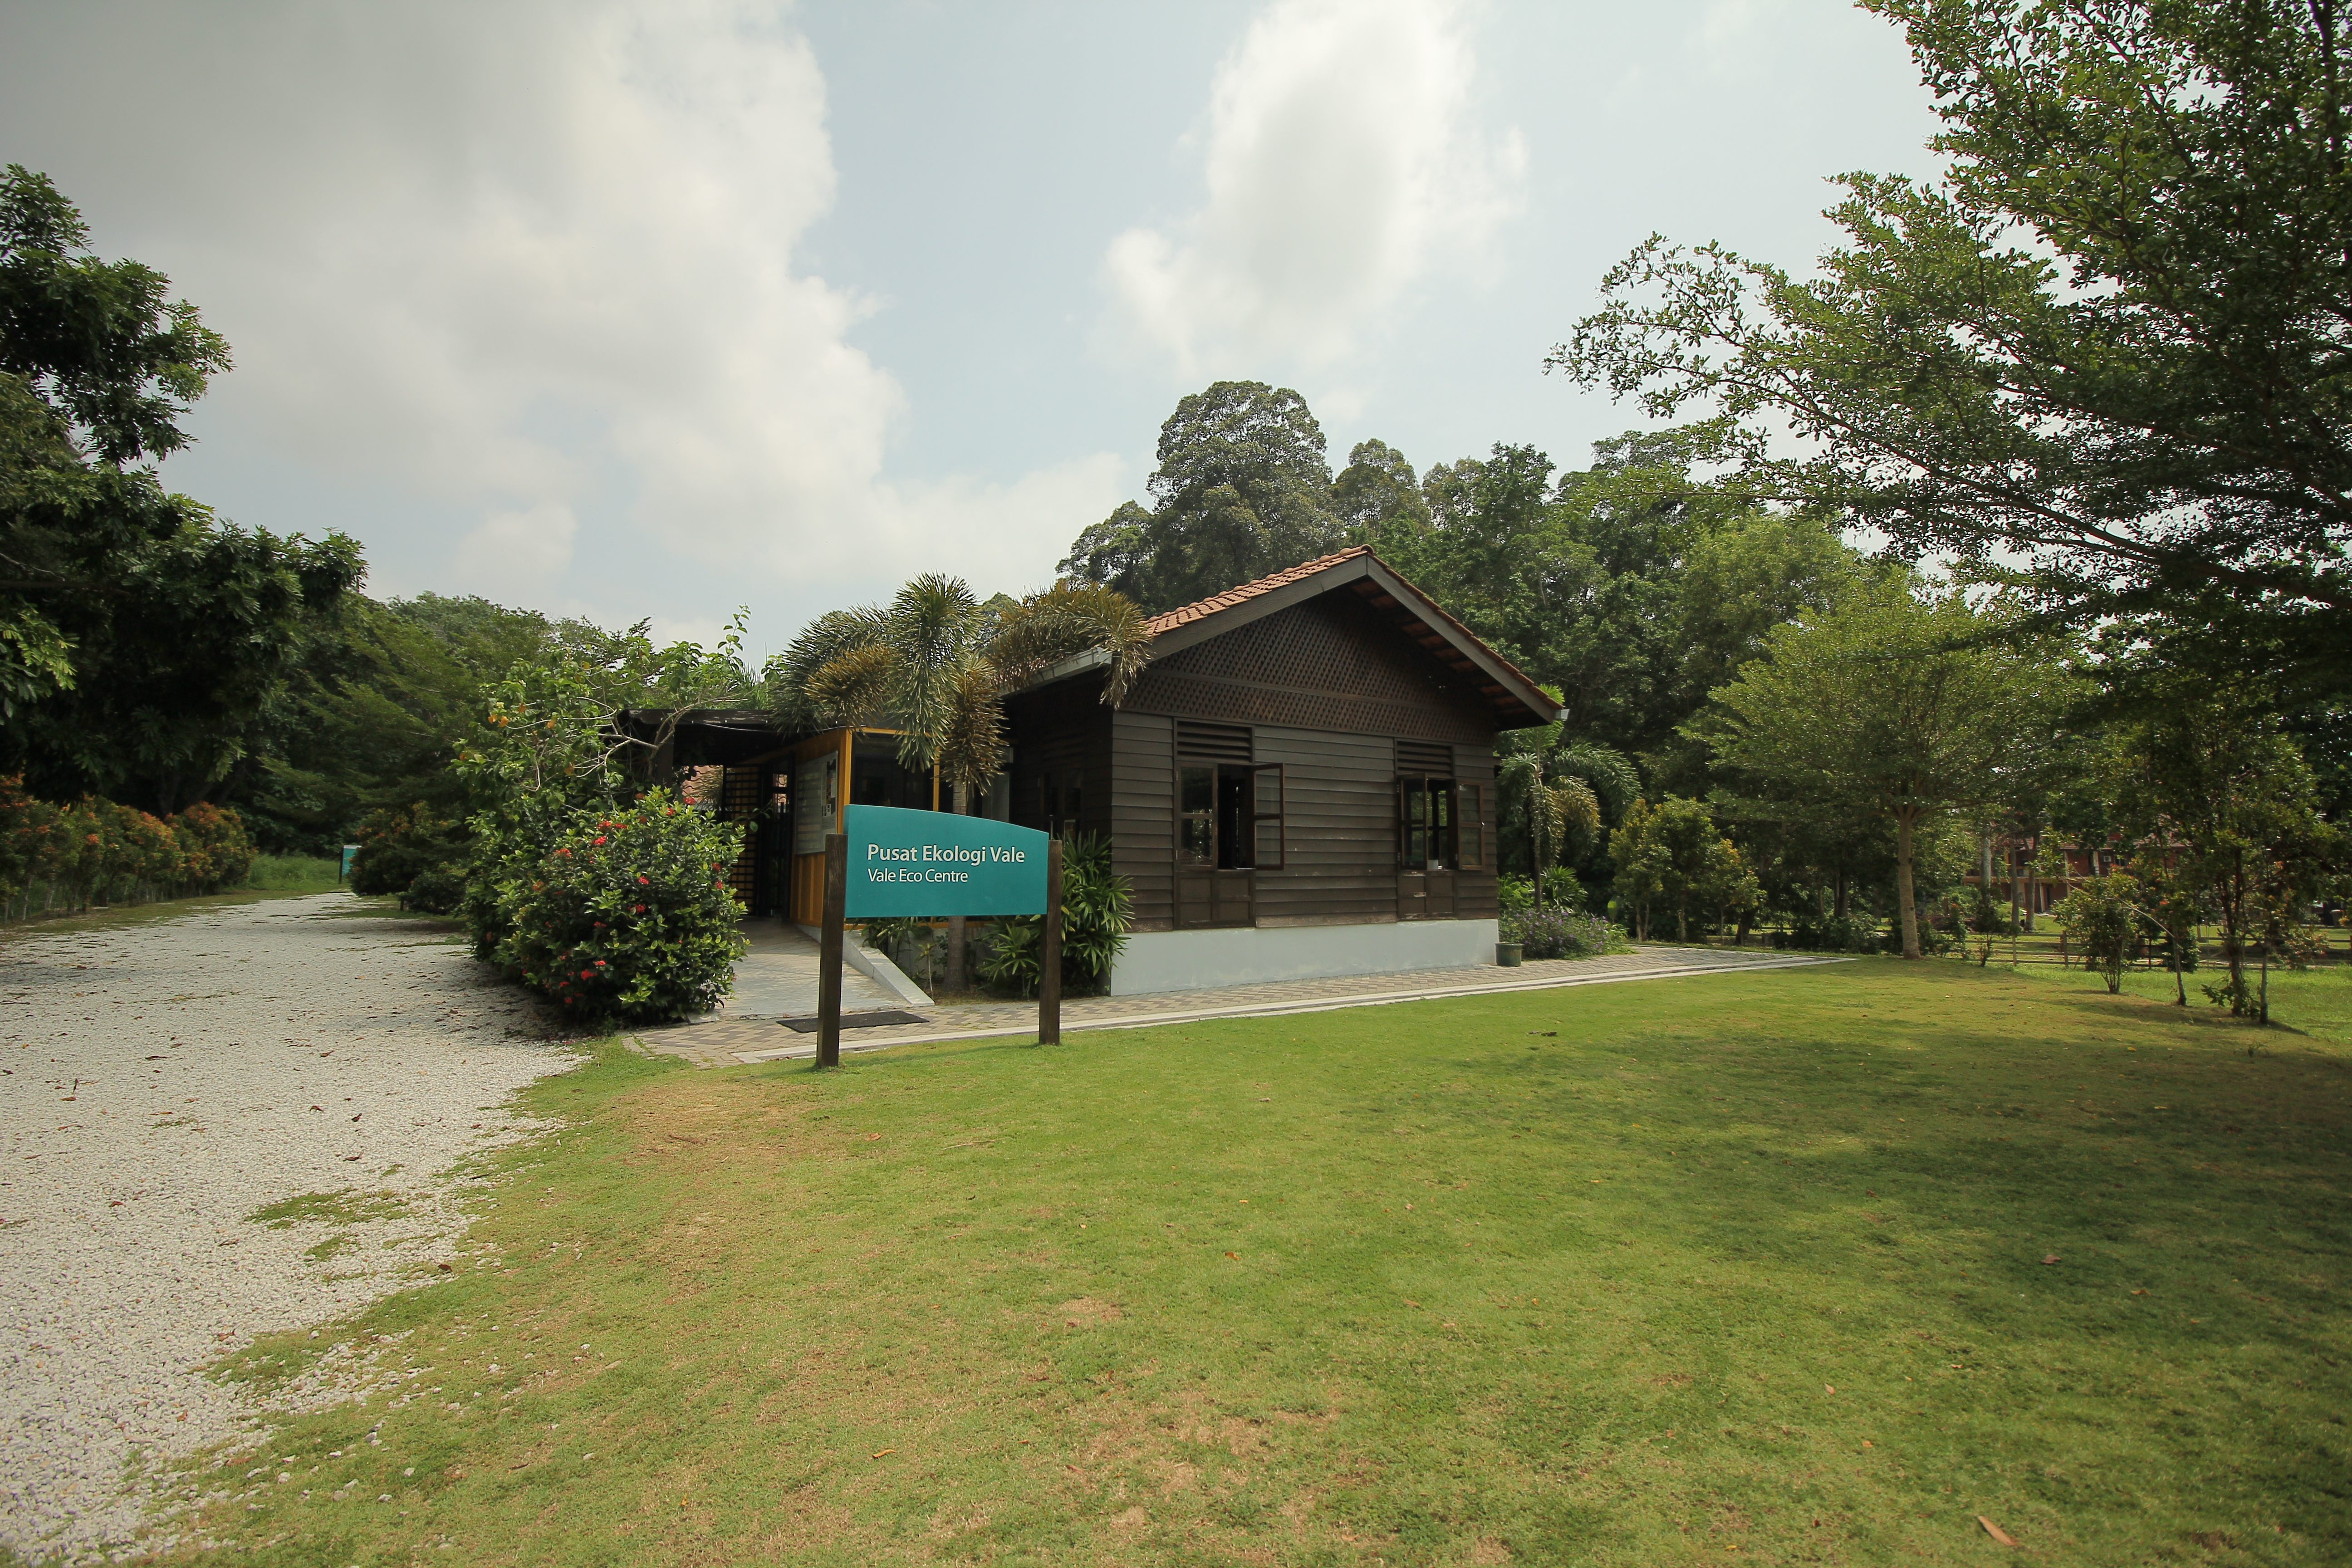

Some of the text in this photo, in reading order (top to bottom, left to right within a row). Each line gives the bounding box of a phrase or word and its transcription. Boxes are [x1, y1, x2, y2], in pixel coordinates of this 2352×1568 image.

[867, 843, 1025, 866] Pusat Ekologi Vale
[867, 867, 969, 882] Vale Eco Centre
